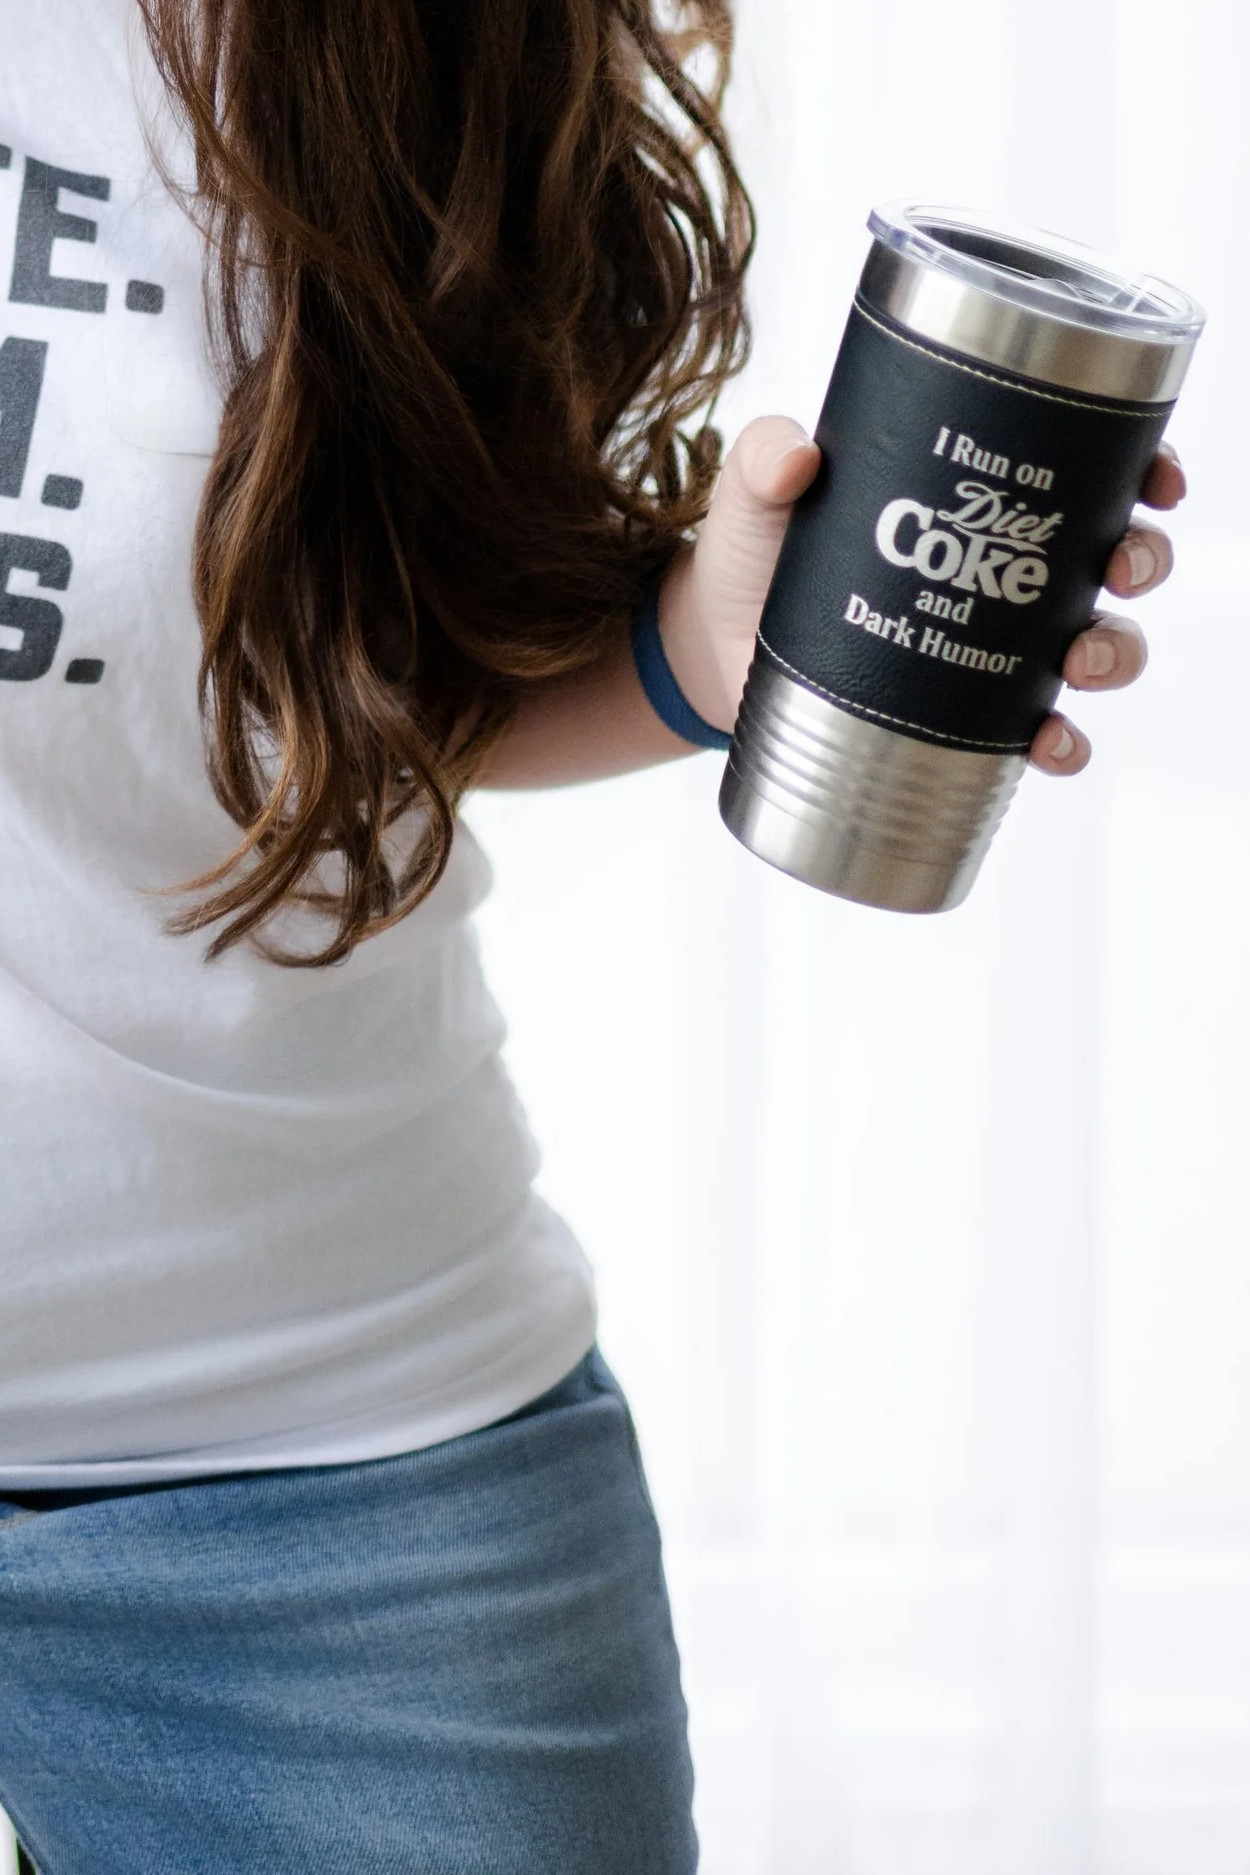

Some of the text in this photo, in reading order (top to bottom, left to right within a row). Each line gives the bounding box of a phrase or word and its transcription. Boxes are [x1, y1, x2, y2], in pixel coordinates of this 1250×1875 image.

[932, 426, 1055, 491] I Run on
[936, 481, 1064, 543] Diet
[875, 498, 1049, 605] Coke
[844, 593, 1023, 676] Dark Humor
[915, 589, 975, 625] and
